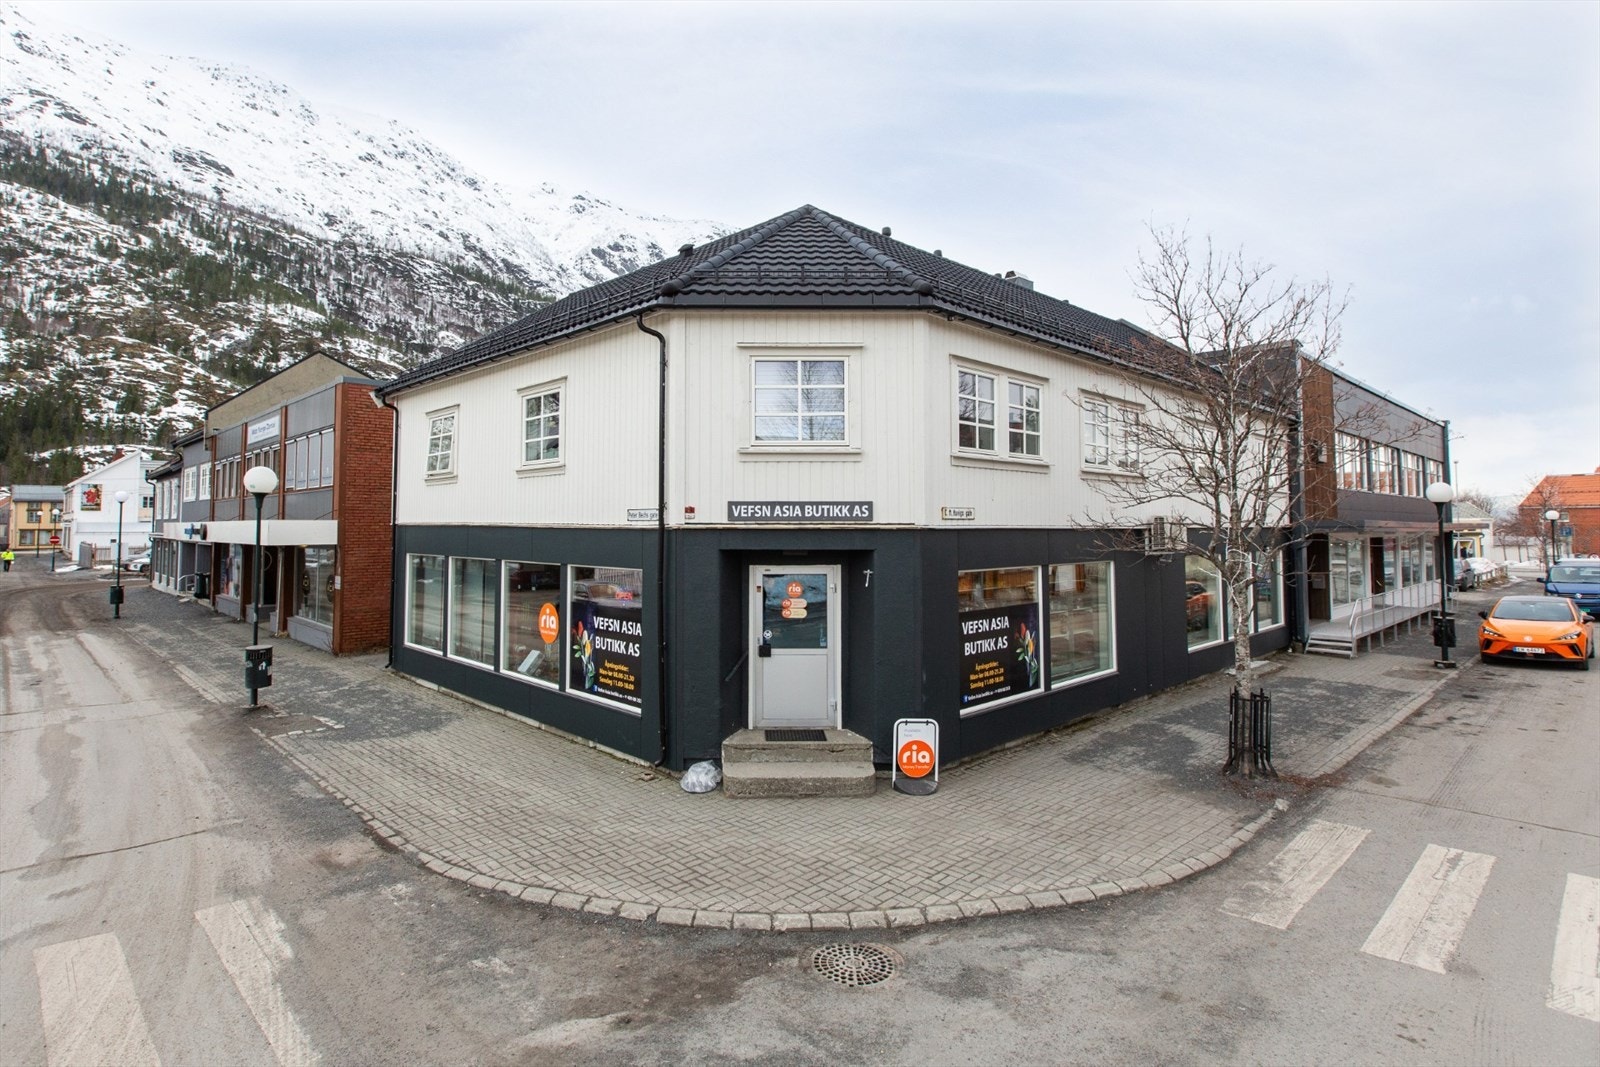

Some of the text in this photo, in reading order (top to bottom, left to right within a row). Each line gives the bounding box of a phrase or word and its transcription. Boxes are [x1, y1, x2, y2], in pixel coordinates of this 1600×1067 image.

[732, 505, 869, 517] VEFSN ASIA BUTIKK AS
[788, 584, 801, 592] ria
[541, 608, 556, 629] ria
[594, 616, 642, 636] VEFSN ASIA
[962, 616, 1009, 635] VEFSN ASIA
[596, 636, 640, 657] BUTIKK AS
[965, 636, 1008, 656] BUTIKK AS
[903, 744, 930, 764] ria
